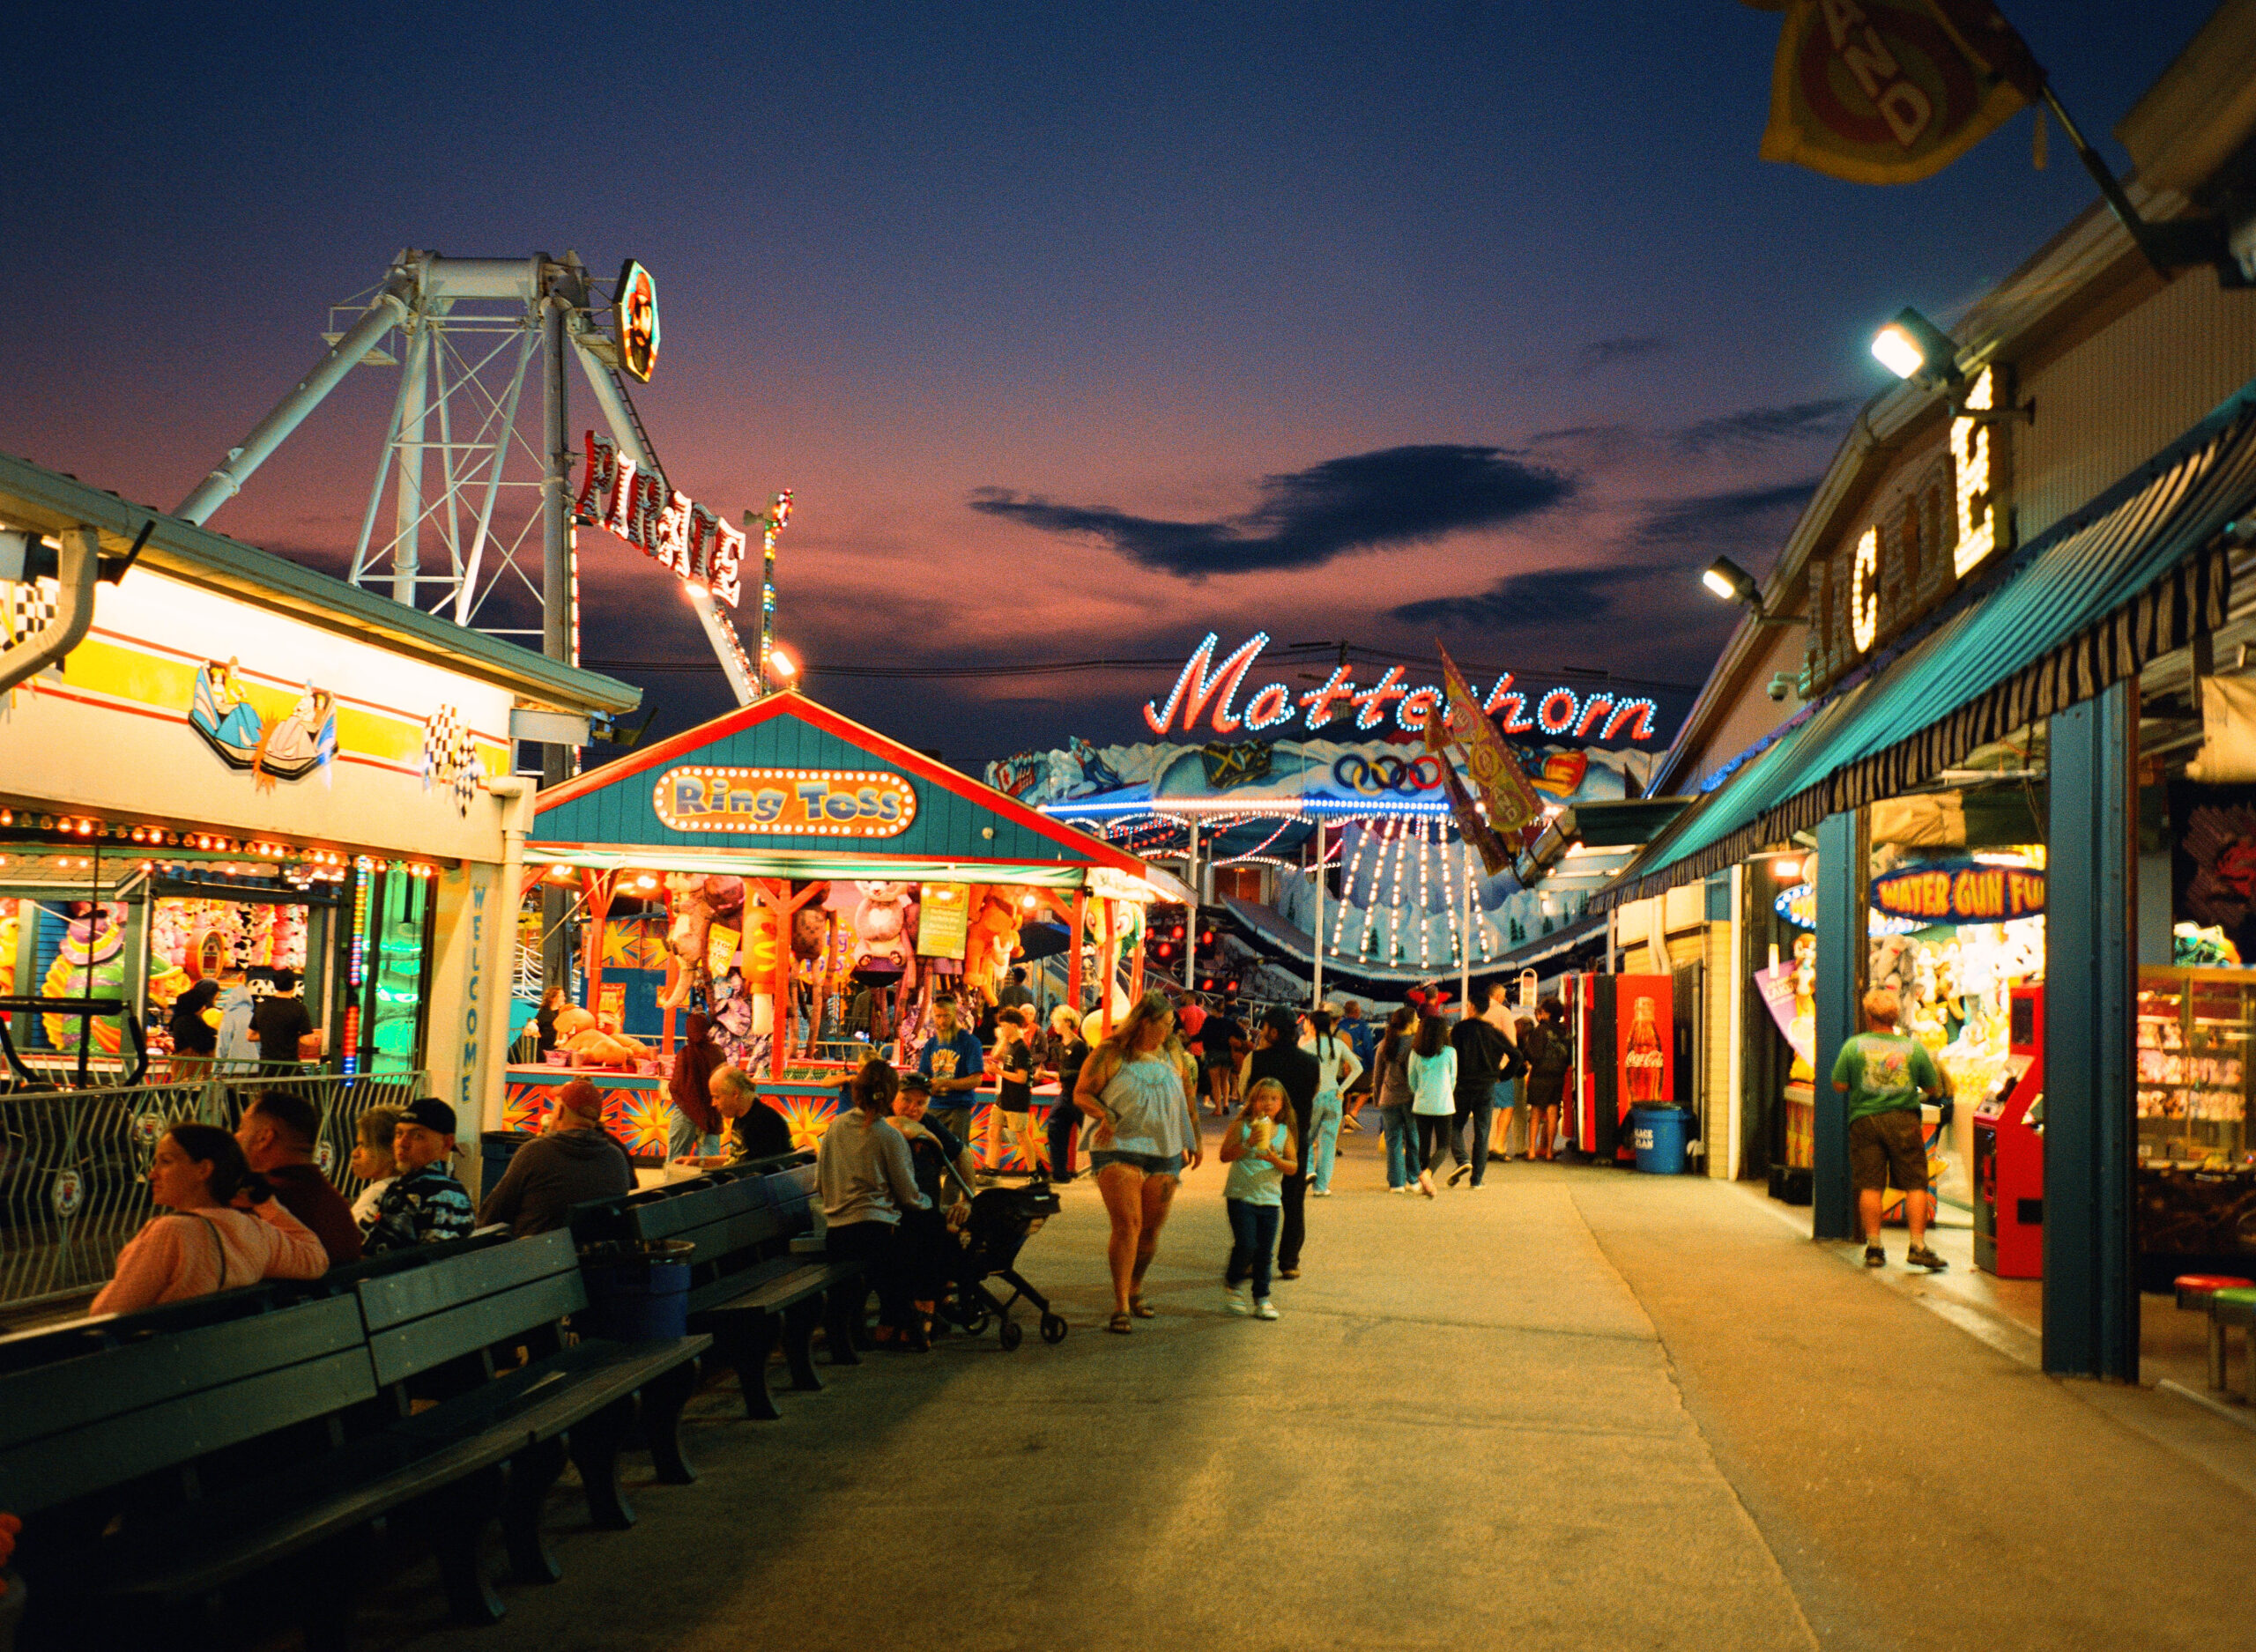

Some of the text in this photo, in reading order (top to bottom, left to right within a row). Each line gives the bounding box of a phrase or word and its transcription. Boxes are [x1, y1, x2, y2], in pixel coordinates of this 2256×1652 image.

[575, 430, 746, 608] PIRATE
[673, 775, 902, 823] Ring Toss
[1878, 870, 1951, 917] WATER
[1953, 869, 2005, 916] GUN
[460, 885, 486, 1102] WELCOME
[1626, 1049, 1664, 1069] Coca-Cola
